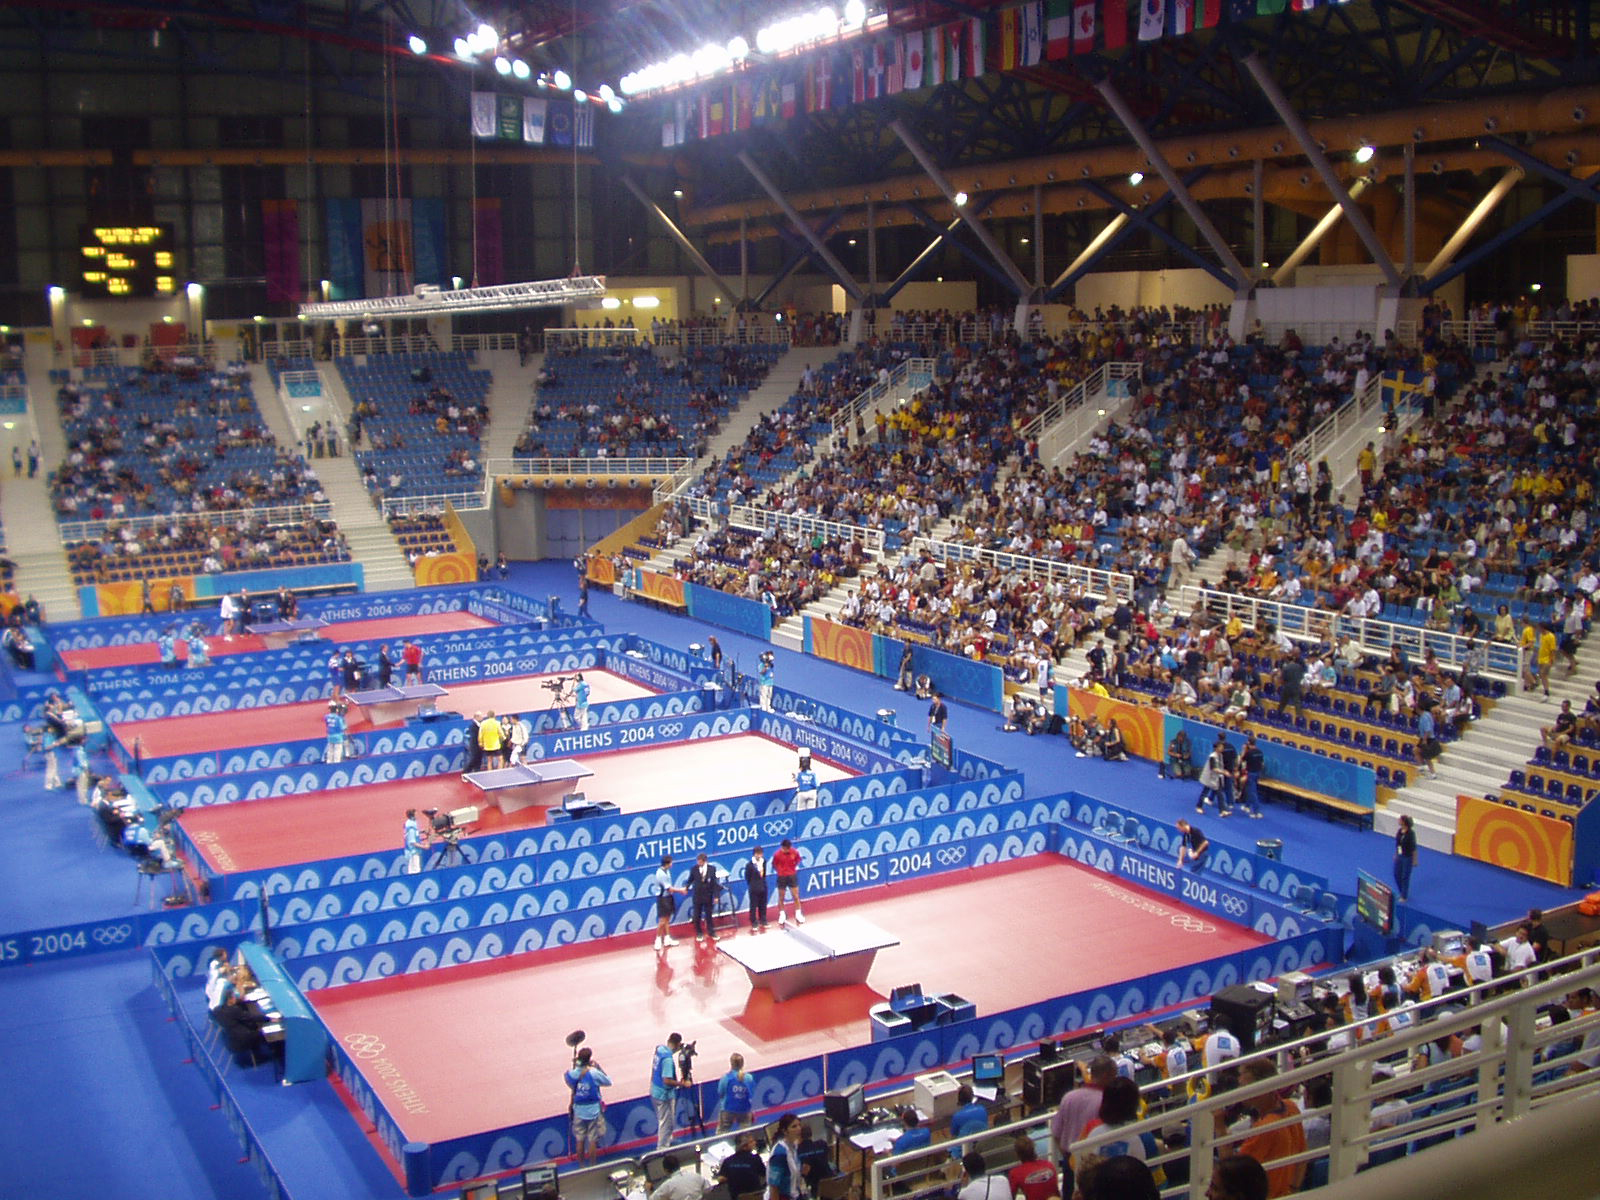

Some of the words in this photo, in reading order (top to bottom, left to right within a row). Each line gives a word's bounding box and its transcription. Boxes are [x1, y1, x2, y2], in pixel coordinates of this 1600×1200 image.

[320, 607, 361, 621] ATHENS
[367, 604, 392, 617] 2004
[391, 645, 437, 658] ATNS
[427, 666, 477, 682] ATHENS
[484, 661, 513, 676] 2004
[88, 678, 140, 692] ATHENS
[553, 731, 612, 753] ATHENS
[620, 726, 655, 744] 2004
[796, 728, 827, 752] ATHENS
[831, 741, 851, 762] 2004
[635, 832, 707, 860] ATHENS
[717, 824, 759, 846] 2004
[807, 862, 880, 892] ATHENS
[889, 852, 931, 876] 2004
[1121, 855, 1176, 890] ATHENS
[1182, 878, 1217, 907] 2004
[32, 930, 88, 956] 2004
